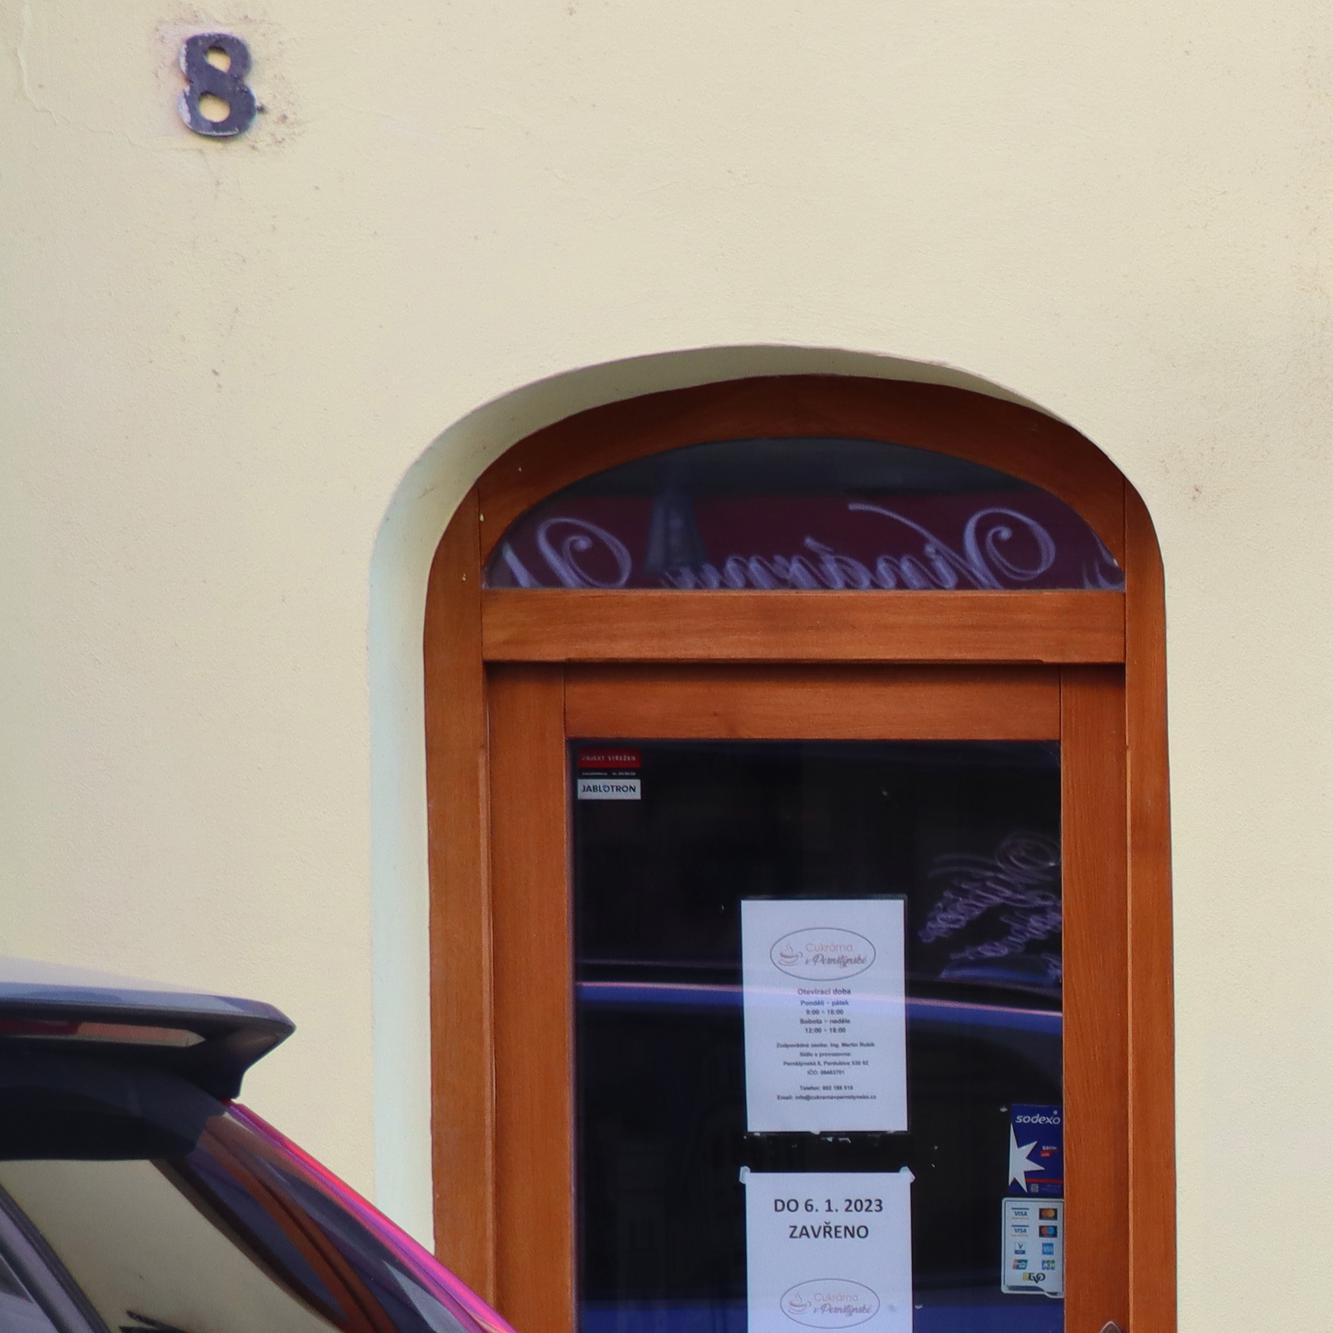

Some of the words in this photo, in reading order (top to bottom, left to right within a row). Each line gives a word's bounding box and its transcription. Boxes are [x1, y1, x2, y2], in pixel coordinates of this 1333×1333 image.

[178, 31, 258, 138] 8
[582, 784, 637, 793] JABLOTRON
[1015, 1111, 1062, 1125] sodexo
[774, 1199, 799, 1212] DO
[804, 1199, 819, 1212] 6.
[825, 1199, 839, 1212] 1.
[844, 1199, 883, 1212] 2023
[789, 1221, 869, 1239] ZAVŘENO
